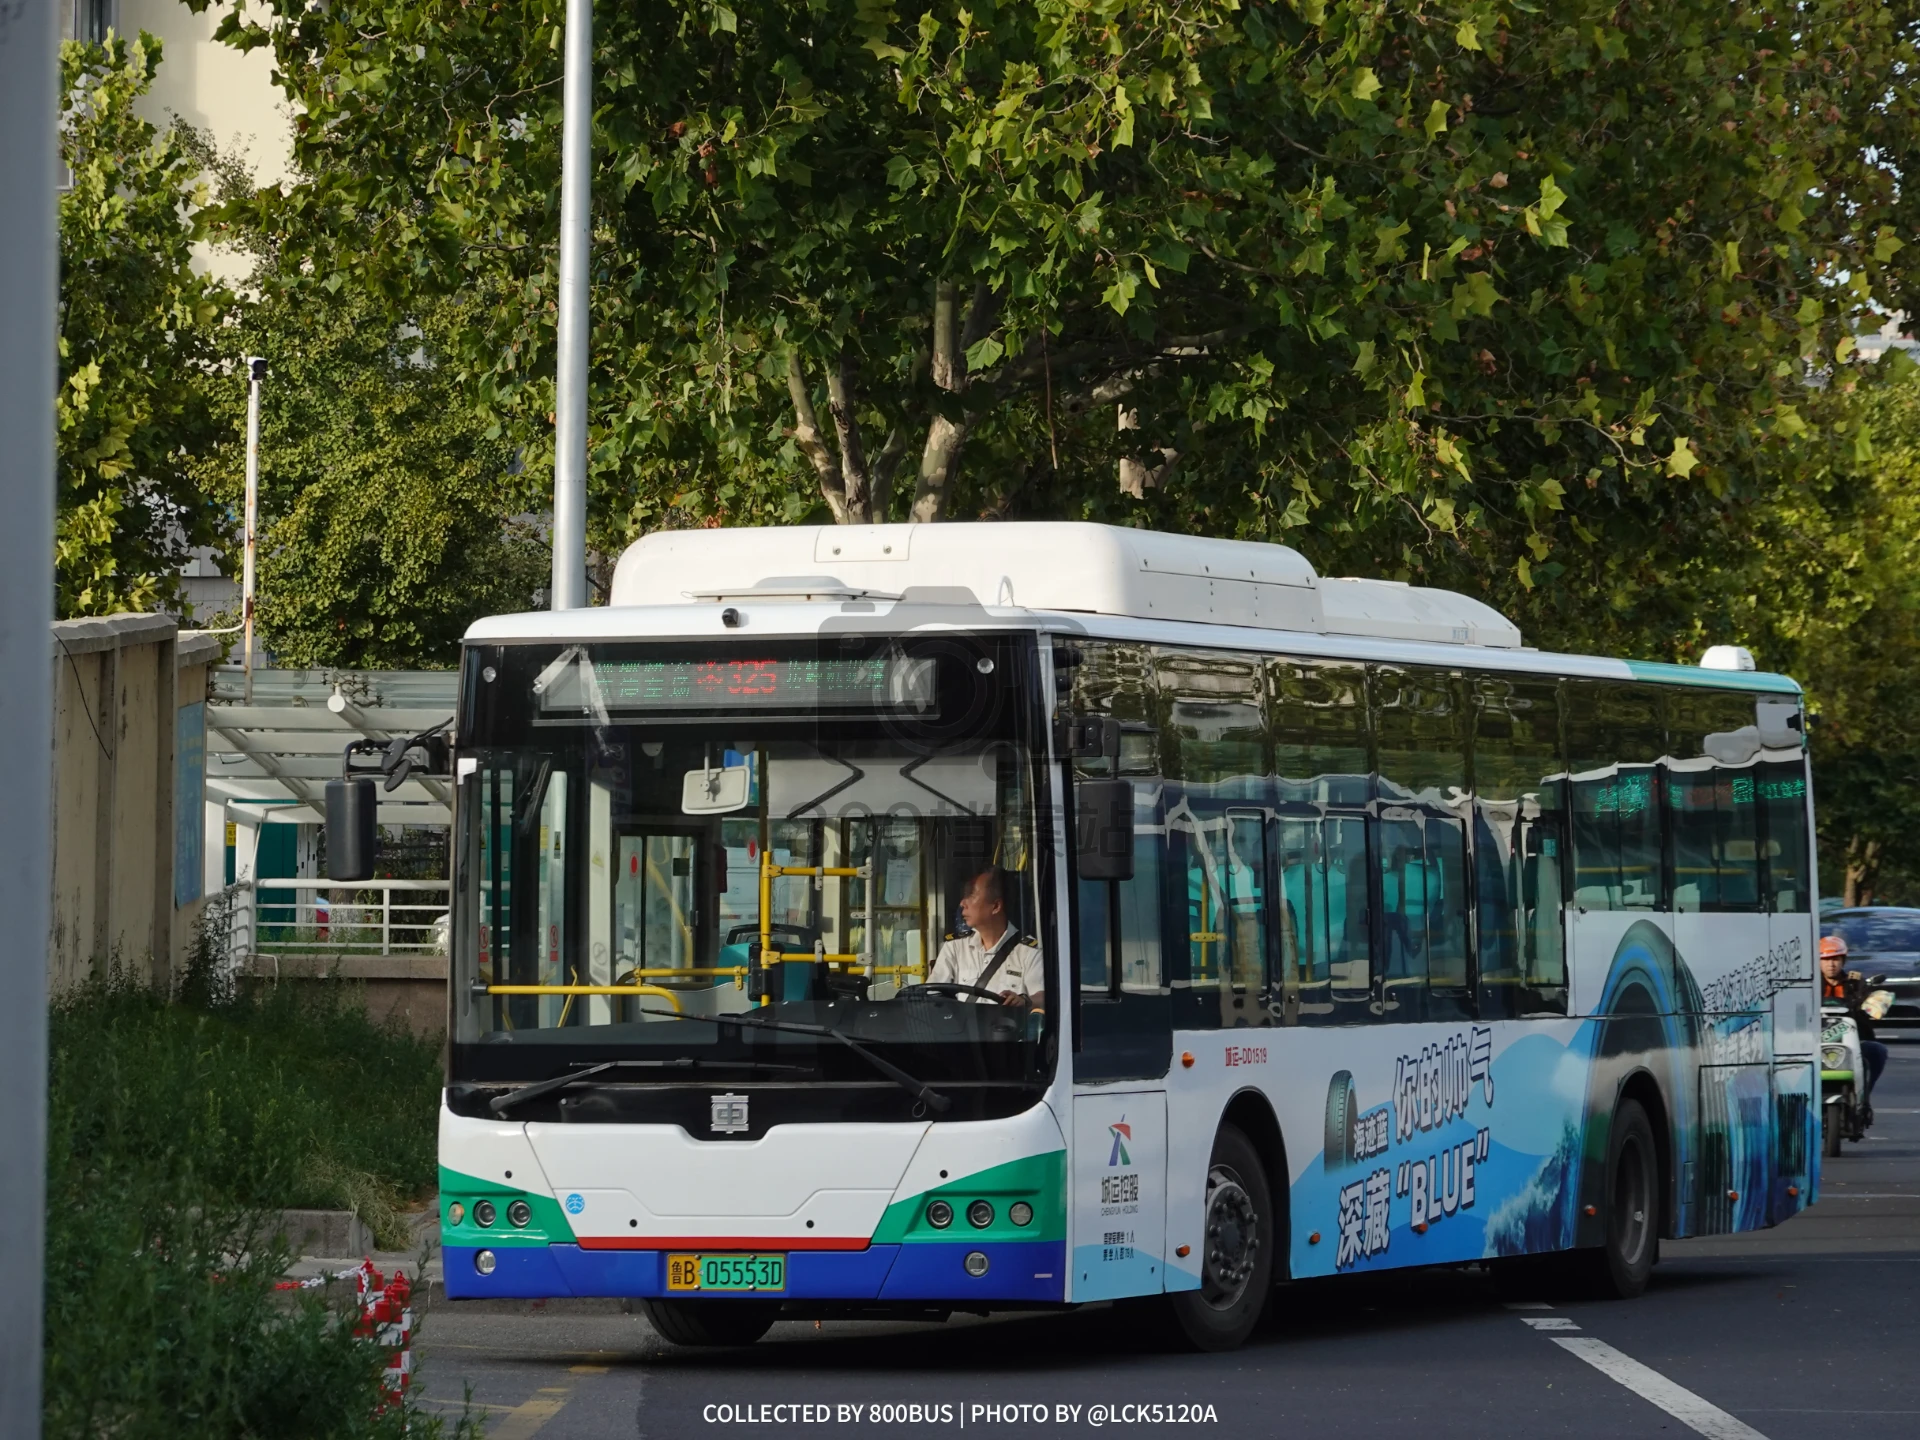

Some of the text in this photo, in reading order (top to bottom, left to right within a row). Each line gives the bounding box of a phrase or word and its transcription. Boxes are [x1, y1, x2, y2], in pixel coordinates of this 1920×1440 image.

[728, 660, 777, 694] 325
[1225, 1046, 1268, 1067] 城运-DD1519
[1393, 1026, 1494, 1144] 你的帅气
[1353, 1108, 1390, 1163] 海迹蓝
[1101, 1174, 1139, 1204] 城运控股
